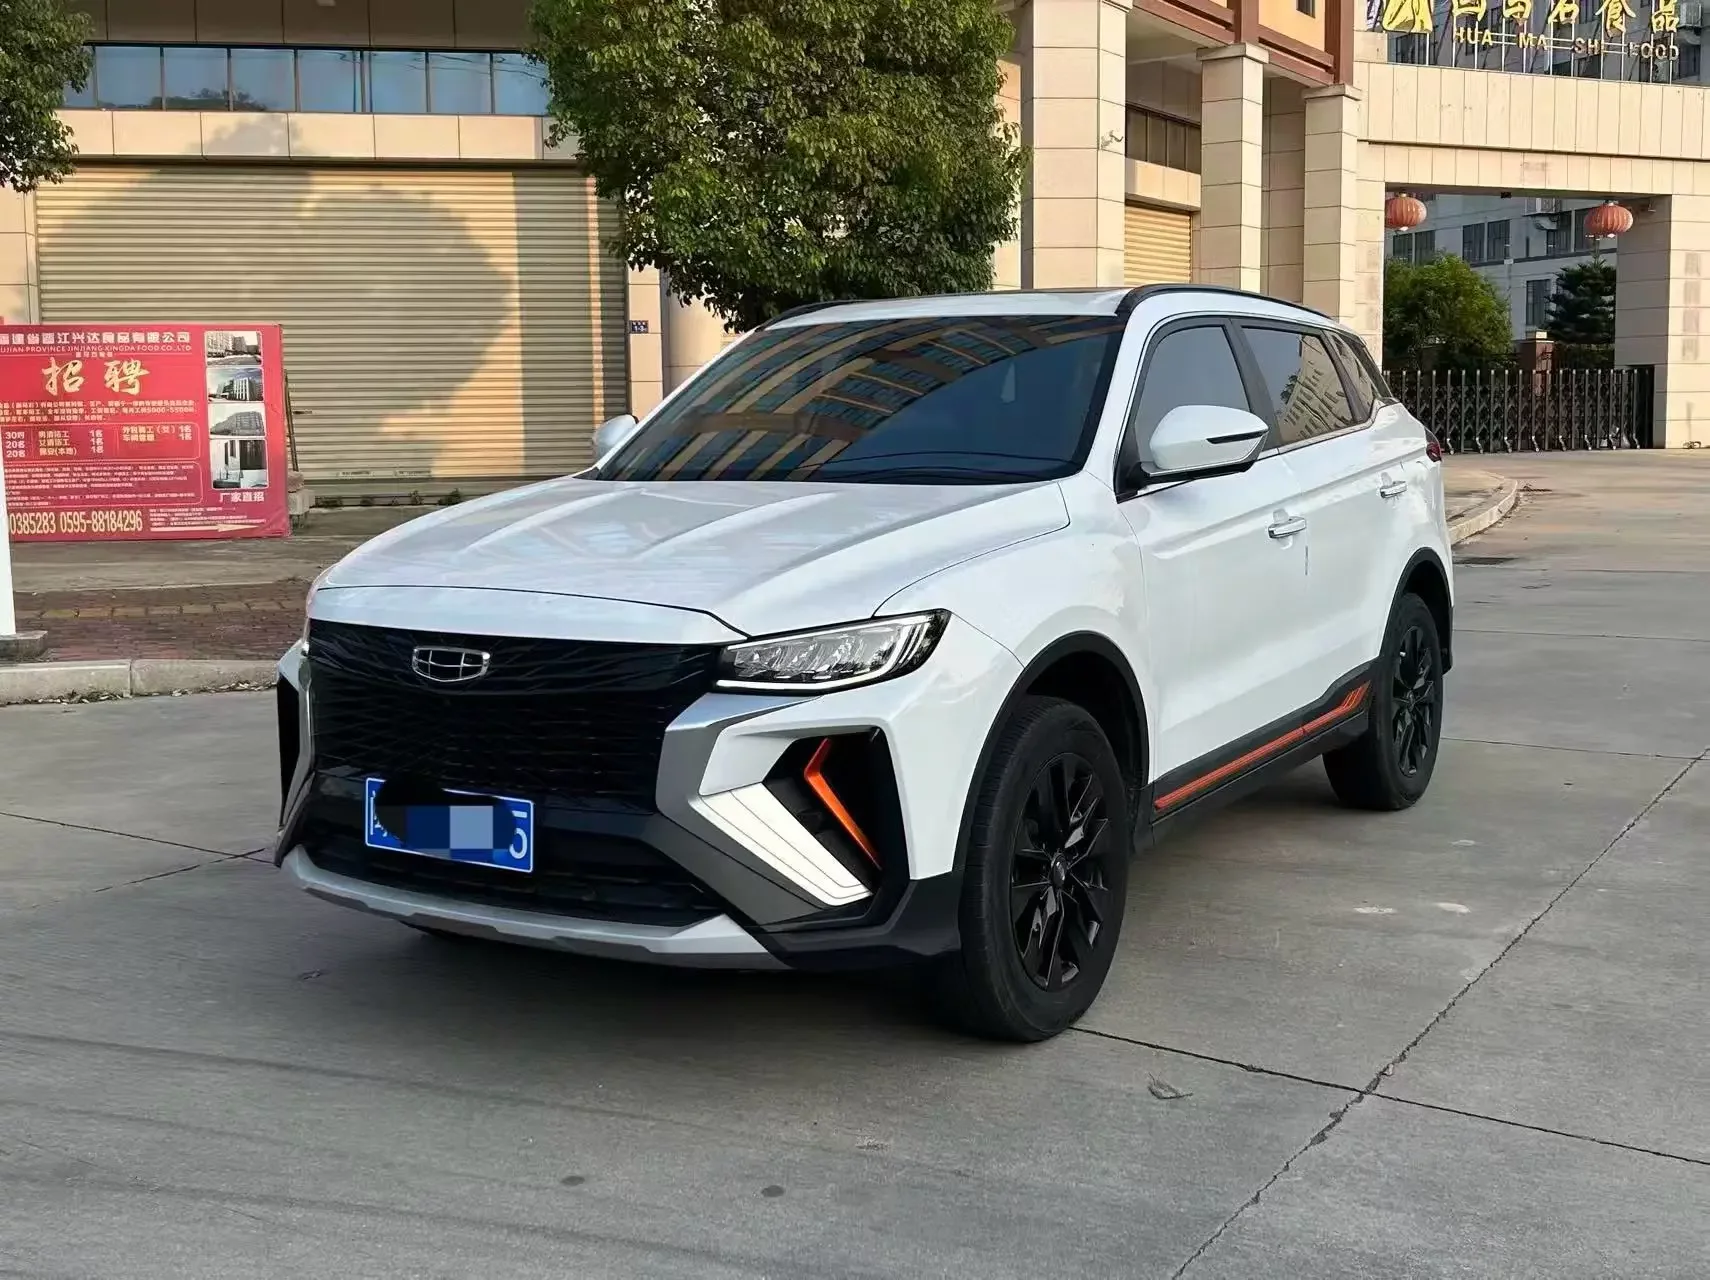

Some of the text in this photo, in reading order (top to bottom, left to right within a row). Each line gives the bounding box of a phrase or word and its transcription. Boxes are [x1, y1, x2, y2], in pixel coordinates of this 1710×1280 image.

[1453, 27, 1493, 46] HUA
[1519, 33, 1548, 51] MA
[1629, 42, 1679, 60] FOOD
[42, 357, 150, 396] 招聘
[60, 510, 143, 533] 0595-88184296
